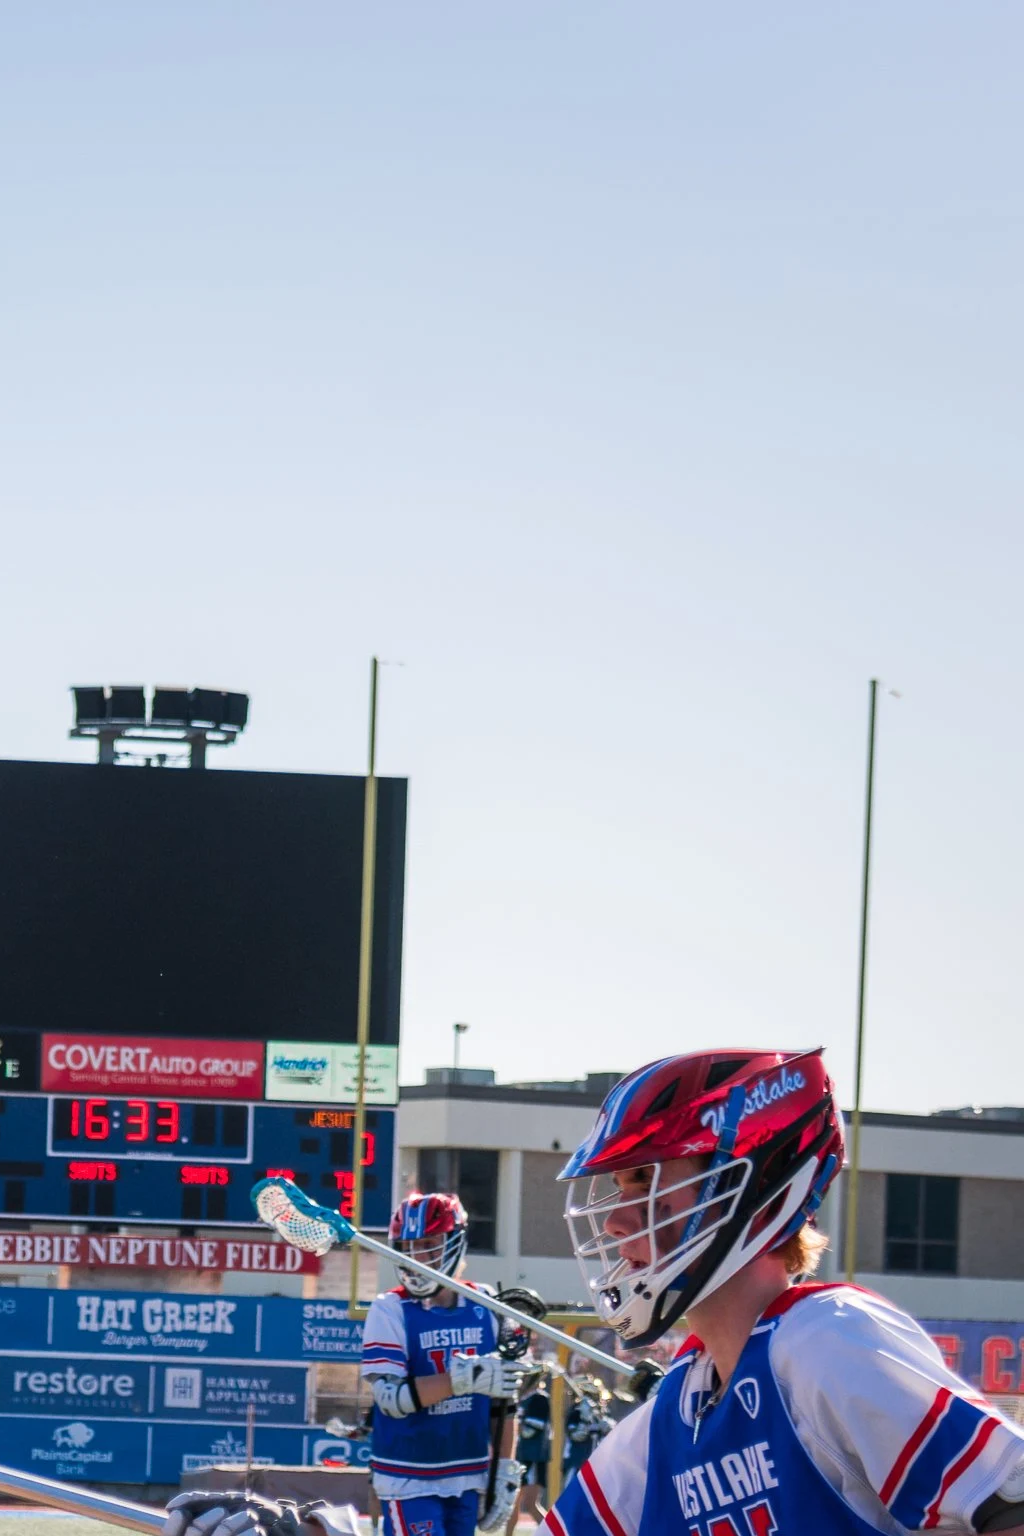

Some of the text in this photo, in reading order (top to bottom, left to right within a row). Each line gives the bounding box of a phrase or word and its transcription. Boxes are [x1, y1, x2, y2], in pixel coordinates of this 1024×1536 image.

[48, 1044, 258, 1077] COVERT AUTO GROUP
[701, 1068, 806, 1136] Wstlake
[71, 1098, 180, 1143] 16:33
[88, 1238, 219, 1268] NEPTUNE
[227, 1243, 303, 1272] FIELD
[77, 1296, 236, 1334] HAT CREEK
[101, 1331, 149, 1349] Burger
[14, 1366, 134, 1396] restore
[205, 1390, 296, 1405] APPLIANCES
[31, 1449, 113, 1463] PlainsCapital
